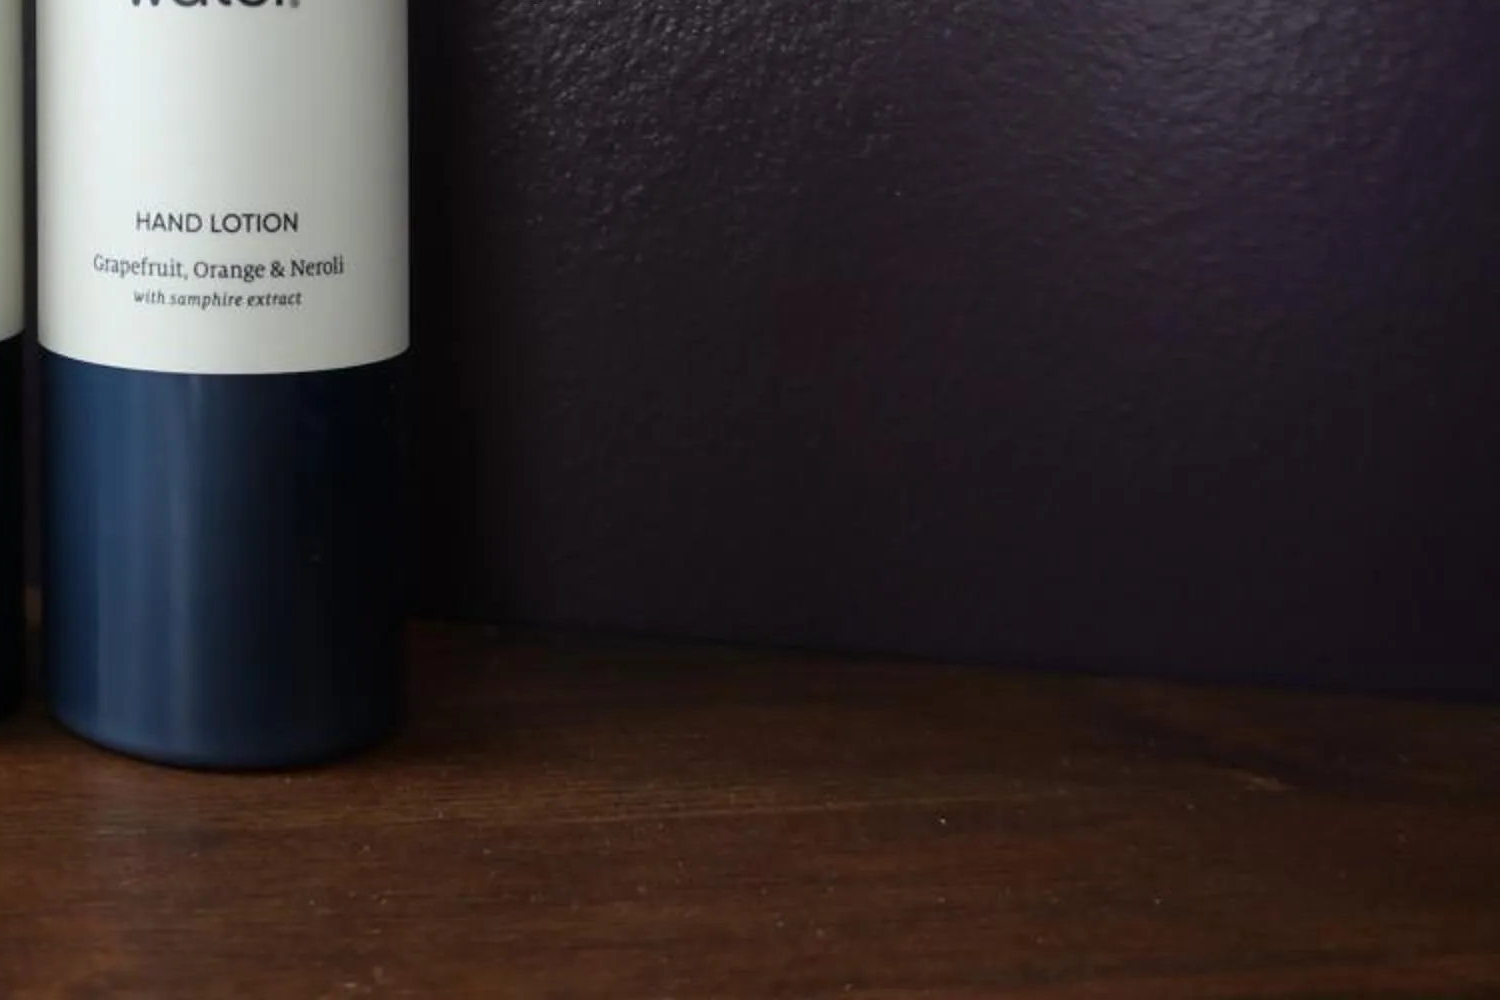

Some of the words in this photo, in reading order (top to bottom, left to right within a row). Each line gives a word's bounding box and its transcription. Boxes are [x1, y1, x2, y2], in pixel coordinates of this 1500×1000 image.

[136, 211, 204, 233] HAND
[210, 211, 300, 234] LOTION
[92, 253, 189, 281] Grapefruit,
[192, 260, 267, 284] Orange
[268, 260, 287, 279] &
[289, 254, 345, 277] Neroli
[132, 289, 167, 306] with
[168, 290, 245, 310] samphire
[246, 290, 304, 307] extract
